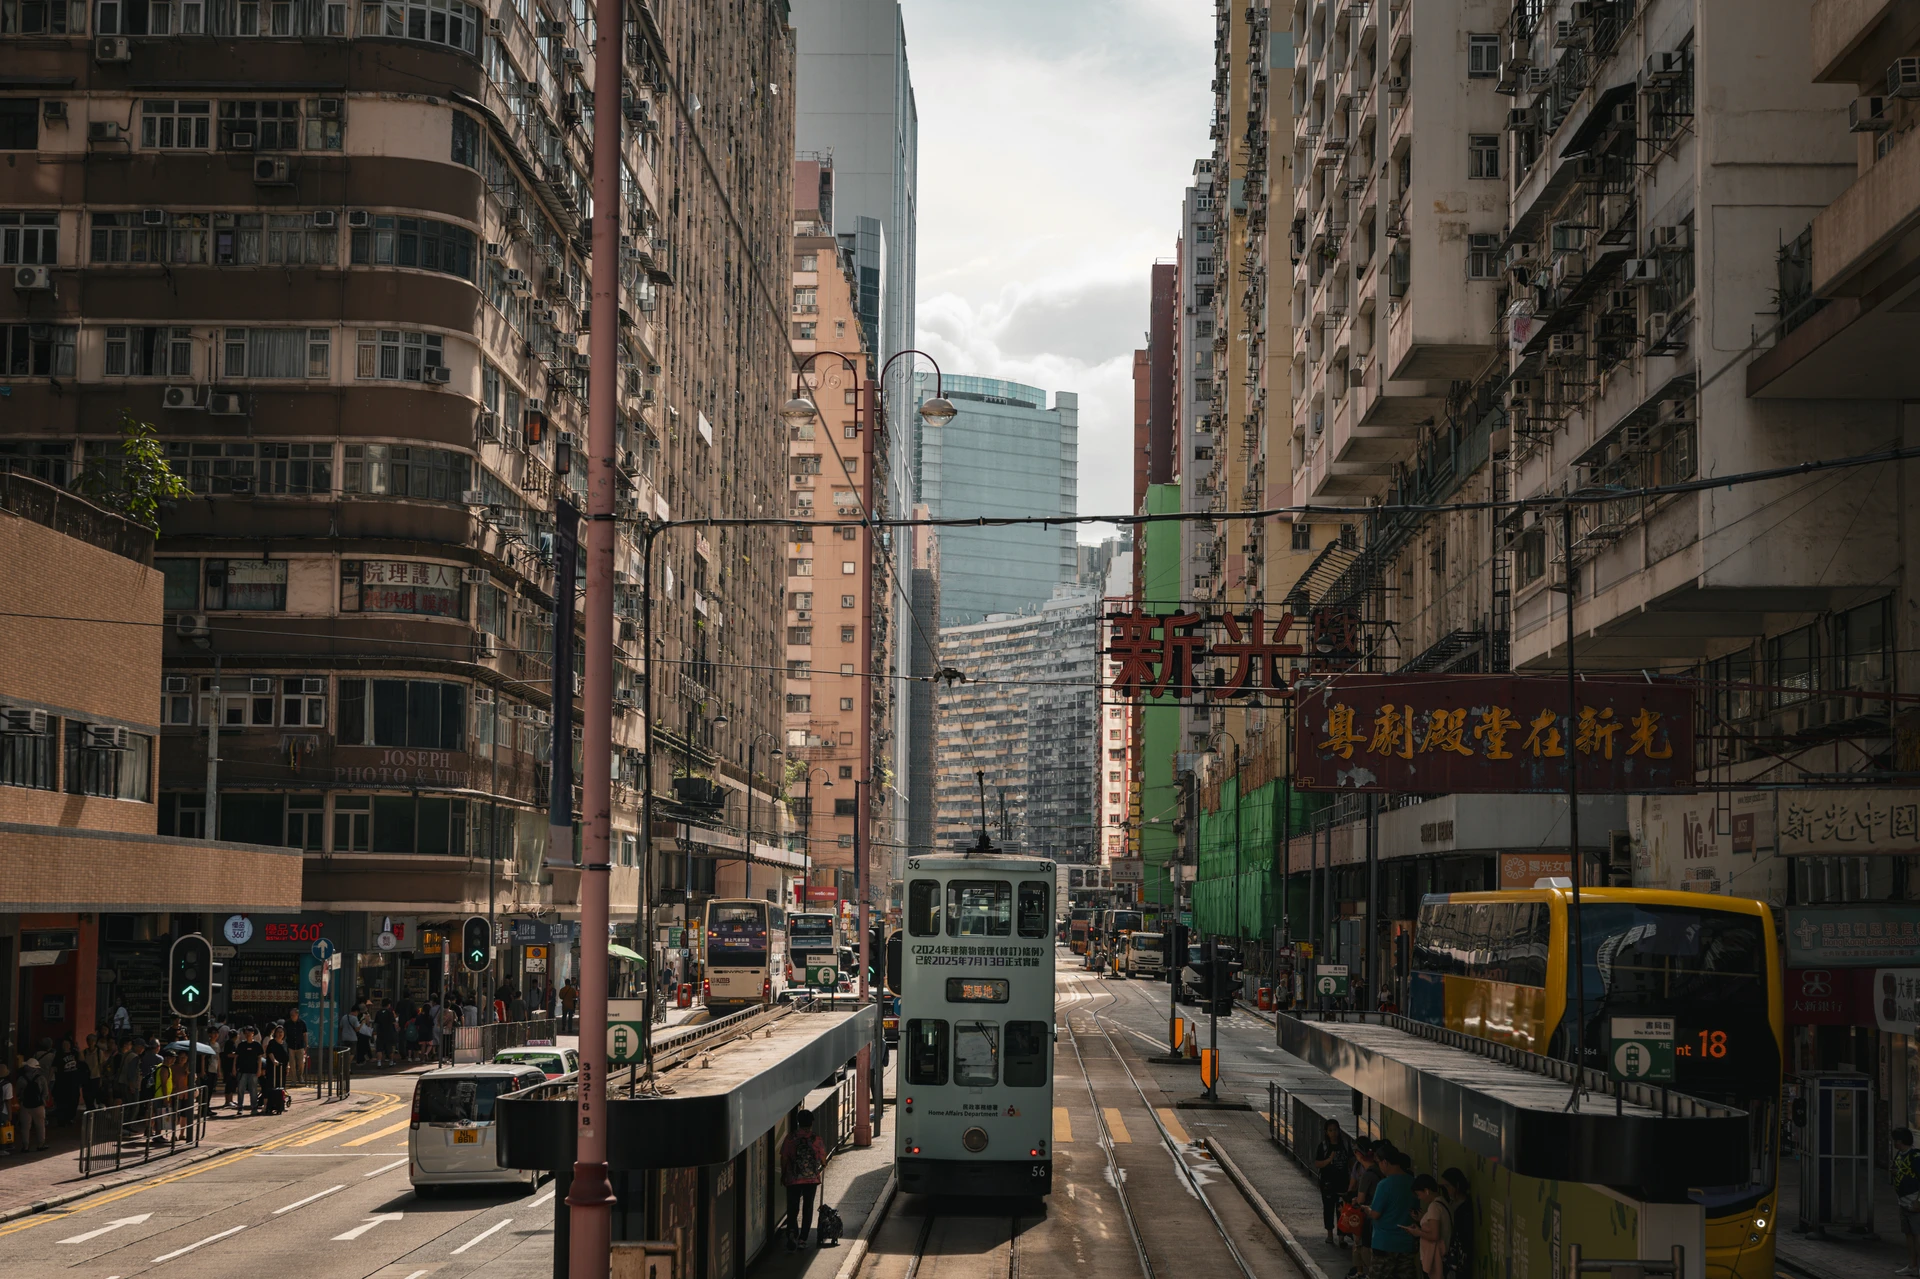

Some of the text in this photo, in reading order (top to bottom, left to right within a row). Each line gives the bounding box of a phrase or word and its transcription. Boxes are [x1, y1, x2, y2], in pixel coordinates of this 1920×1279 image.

[1111, 607, 1303, 700] 新光
[380, 750, 451, 768] JOSEPH
[334, 767, 469, 788] PHOTO & VIDEO
[907, 859, 921, 870] 56
[1039, 861, 1052, 872] 56
[1823, 936, 1917, 948] Hong Kong Grace Baptist
[916, 956, 1040, 968] 已於2025年7月13日正式實施
[963, 985, 994, 999] 跑馬地
[1791, 1000, 1843, 1012] 大新銀行
[1646, 1021, 1671, 1030] 書局街
[1658, 1042, 1671, 1050] 71E
[1698, 1029, 1728, 1059] 18
[1031, 1165, 1046, 1177] 56
